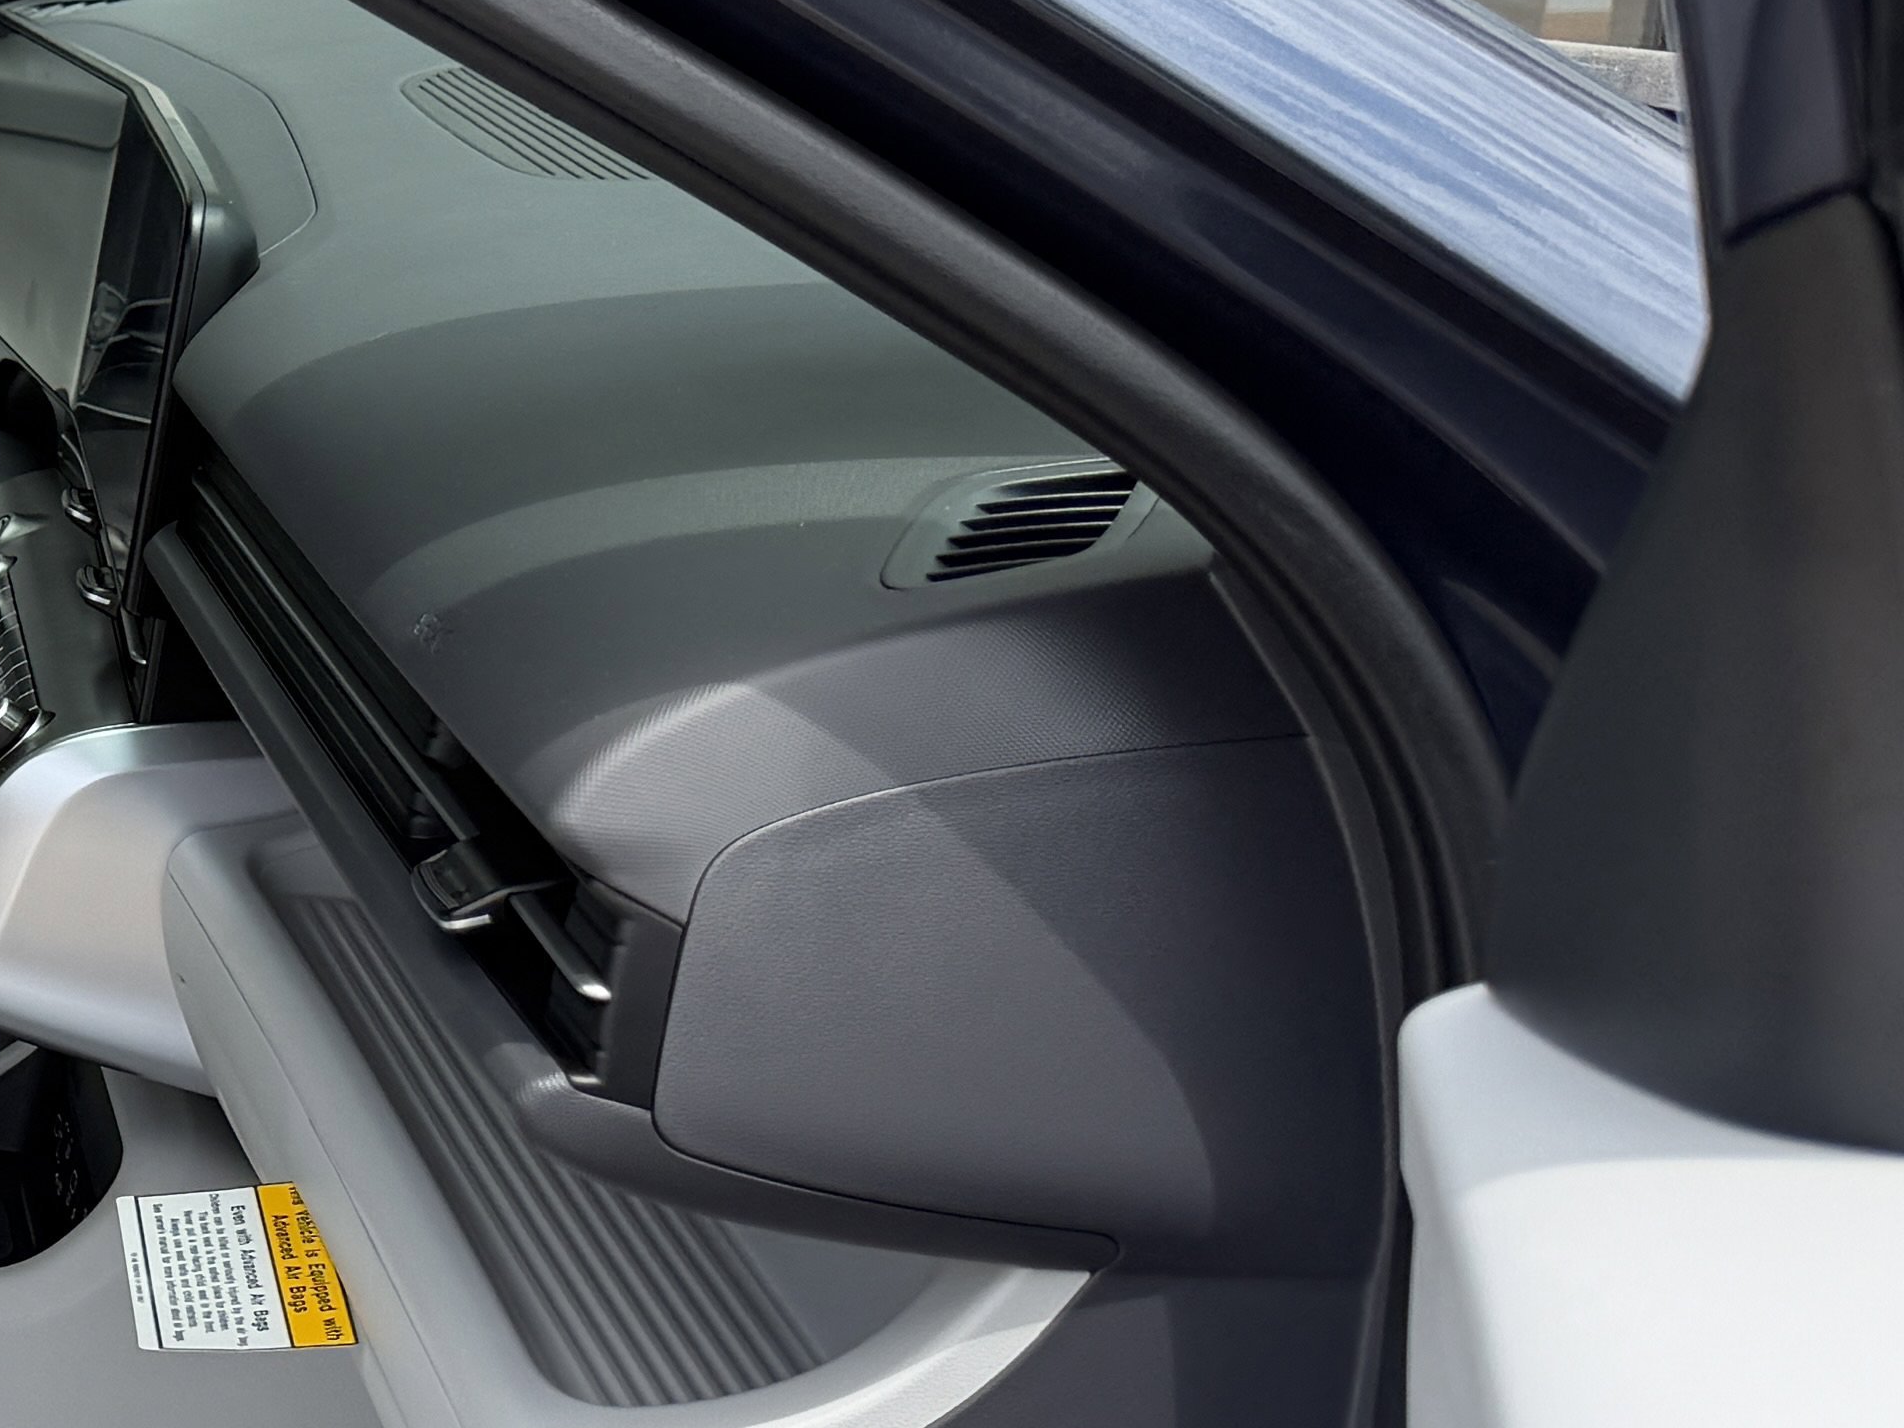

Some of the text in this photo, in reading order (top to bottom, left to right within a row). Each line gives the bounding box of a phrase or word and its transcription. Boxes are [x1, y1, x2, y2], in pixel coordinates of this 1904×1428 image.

[231, 1205, 246, 1225] Even
[272, 1215, 298, 1260] Advanced
[288, 1286, 307, 1313] Bags
[323, 1317, 344, 1340] with
